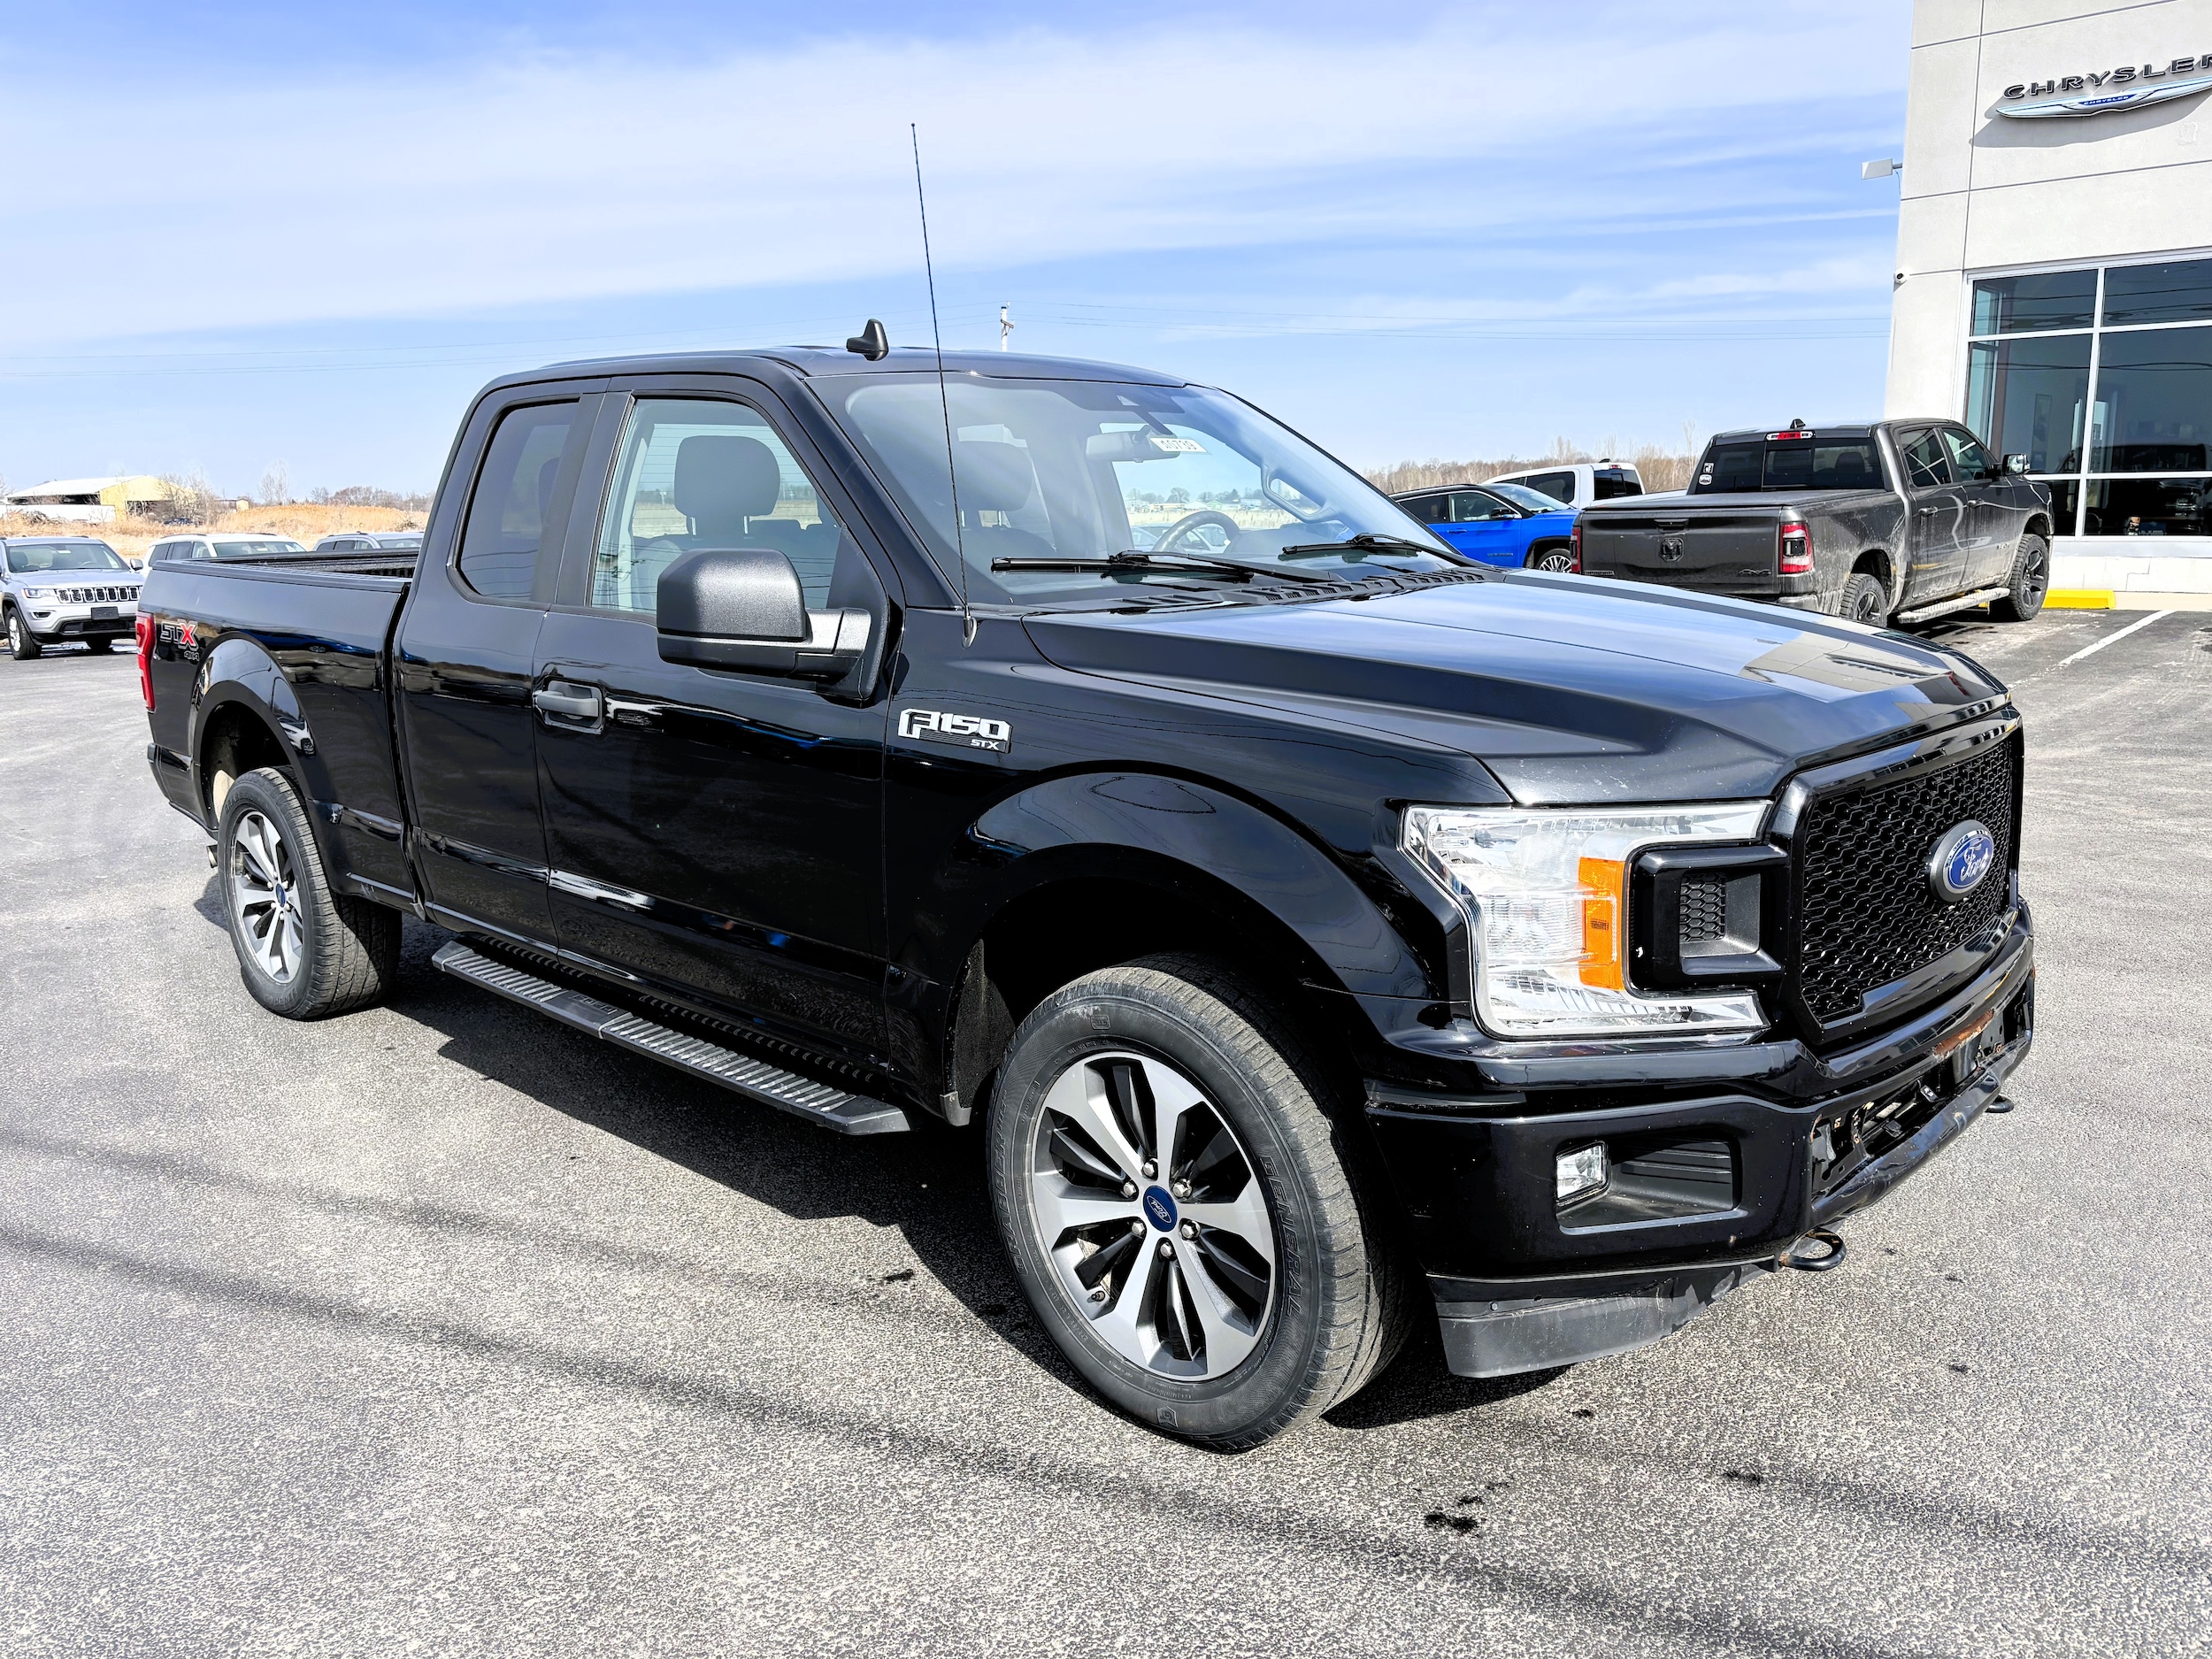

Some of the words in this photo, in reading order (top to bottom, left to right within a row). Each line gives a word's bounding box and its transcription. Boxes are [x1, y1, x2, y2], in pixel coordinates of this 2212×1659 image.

[160, 619, 199, 650] STX
[970, 738, 1000, 751] STX
[1955, 836, 1990, 882] Ford
[1150, 1199, 1168, 1219] Ford
[1259, 1156, 1303, 1317] GENERAL
